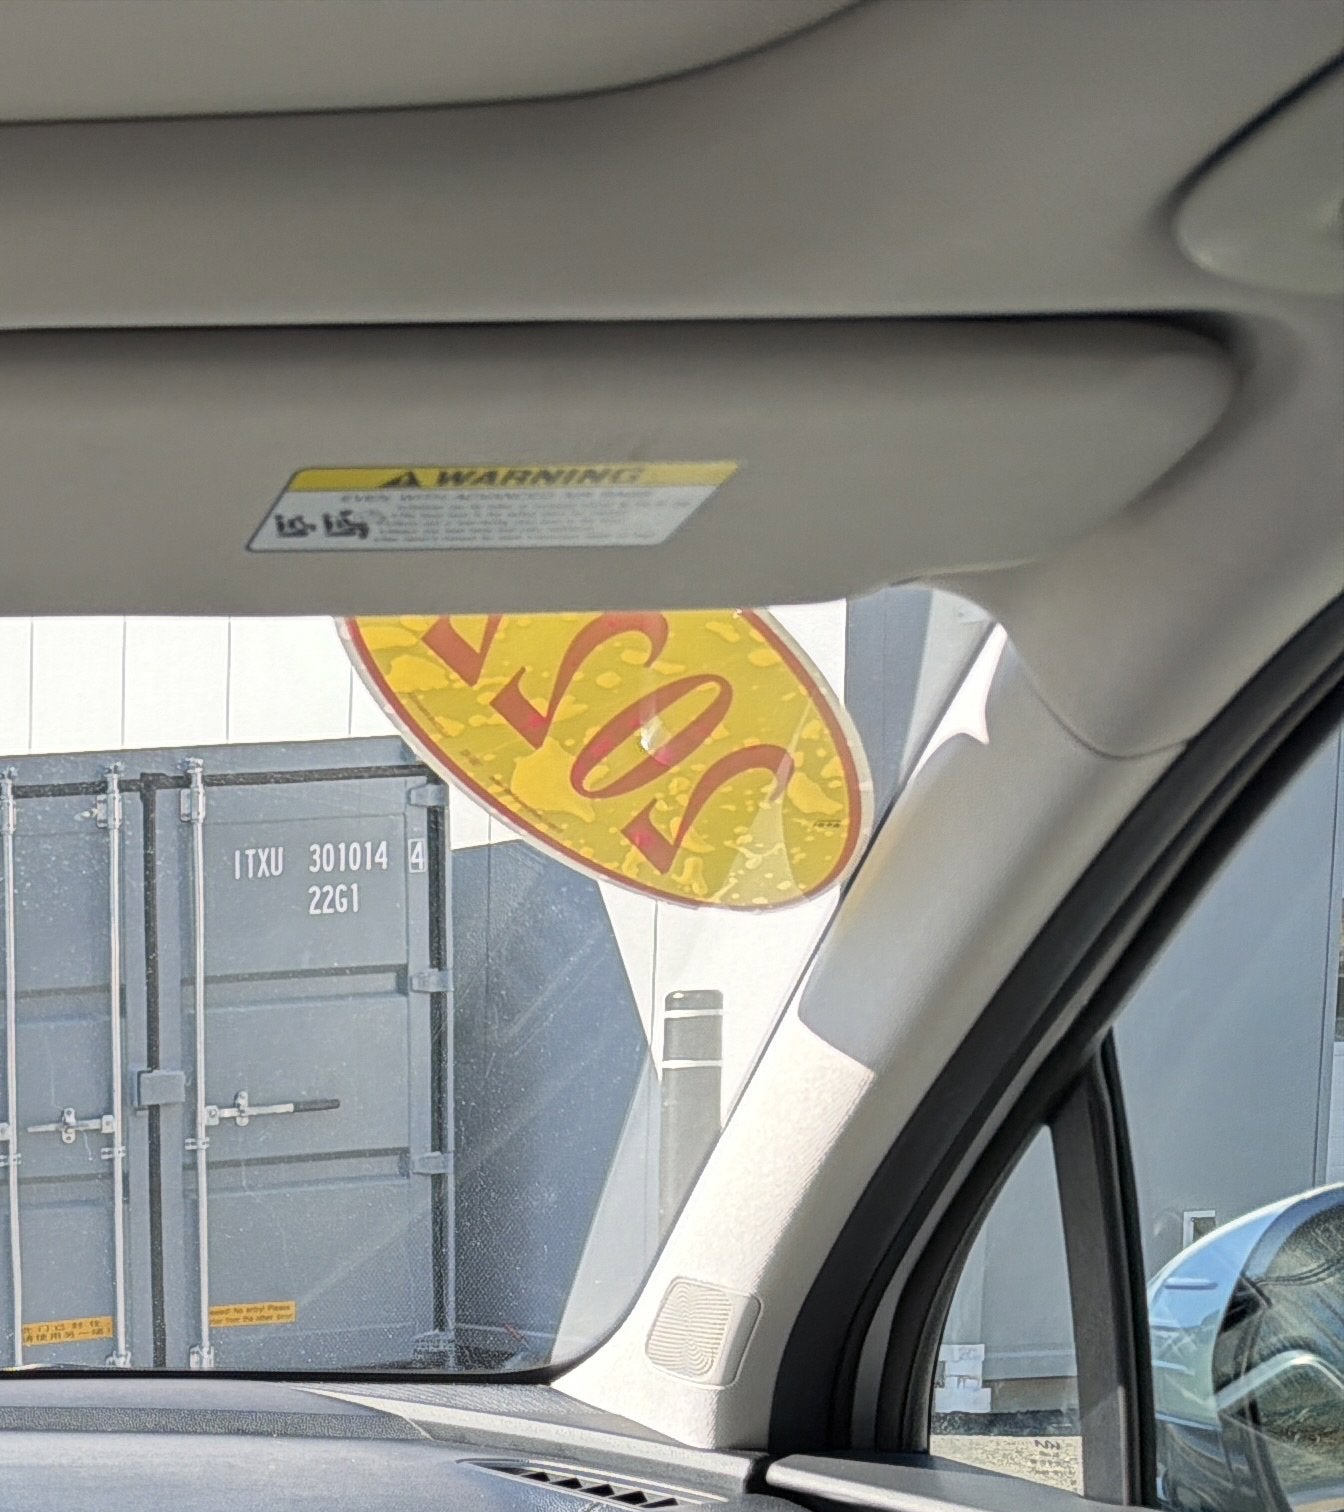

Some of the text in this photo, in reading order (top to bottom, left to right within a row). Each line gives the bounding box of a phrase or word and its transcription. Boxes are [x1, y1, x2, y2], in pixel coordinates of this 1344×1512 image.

[435, 467, 645, 488] WARNING
[234, 840, 425, 880] ITXU 301014 4
[308, 882, 360, 915] 22G1
